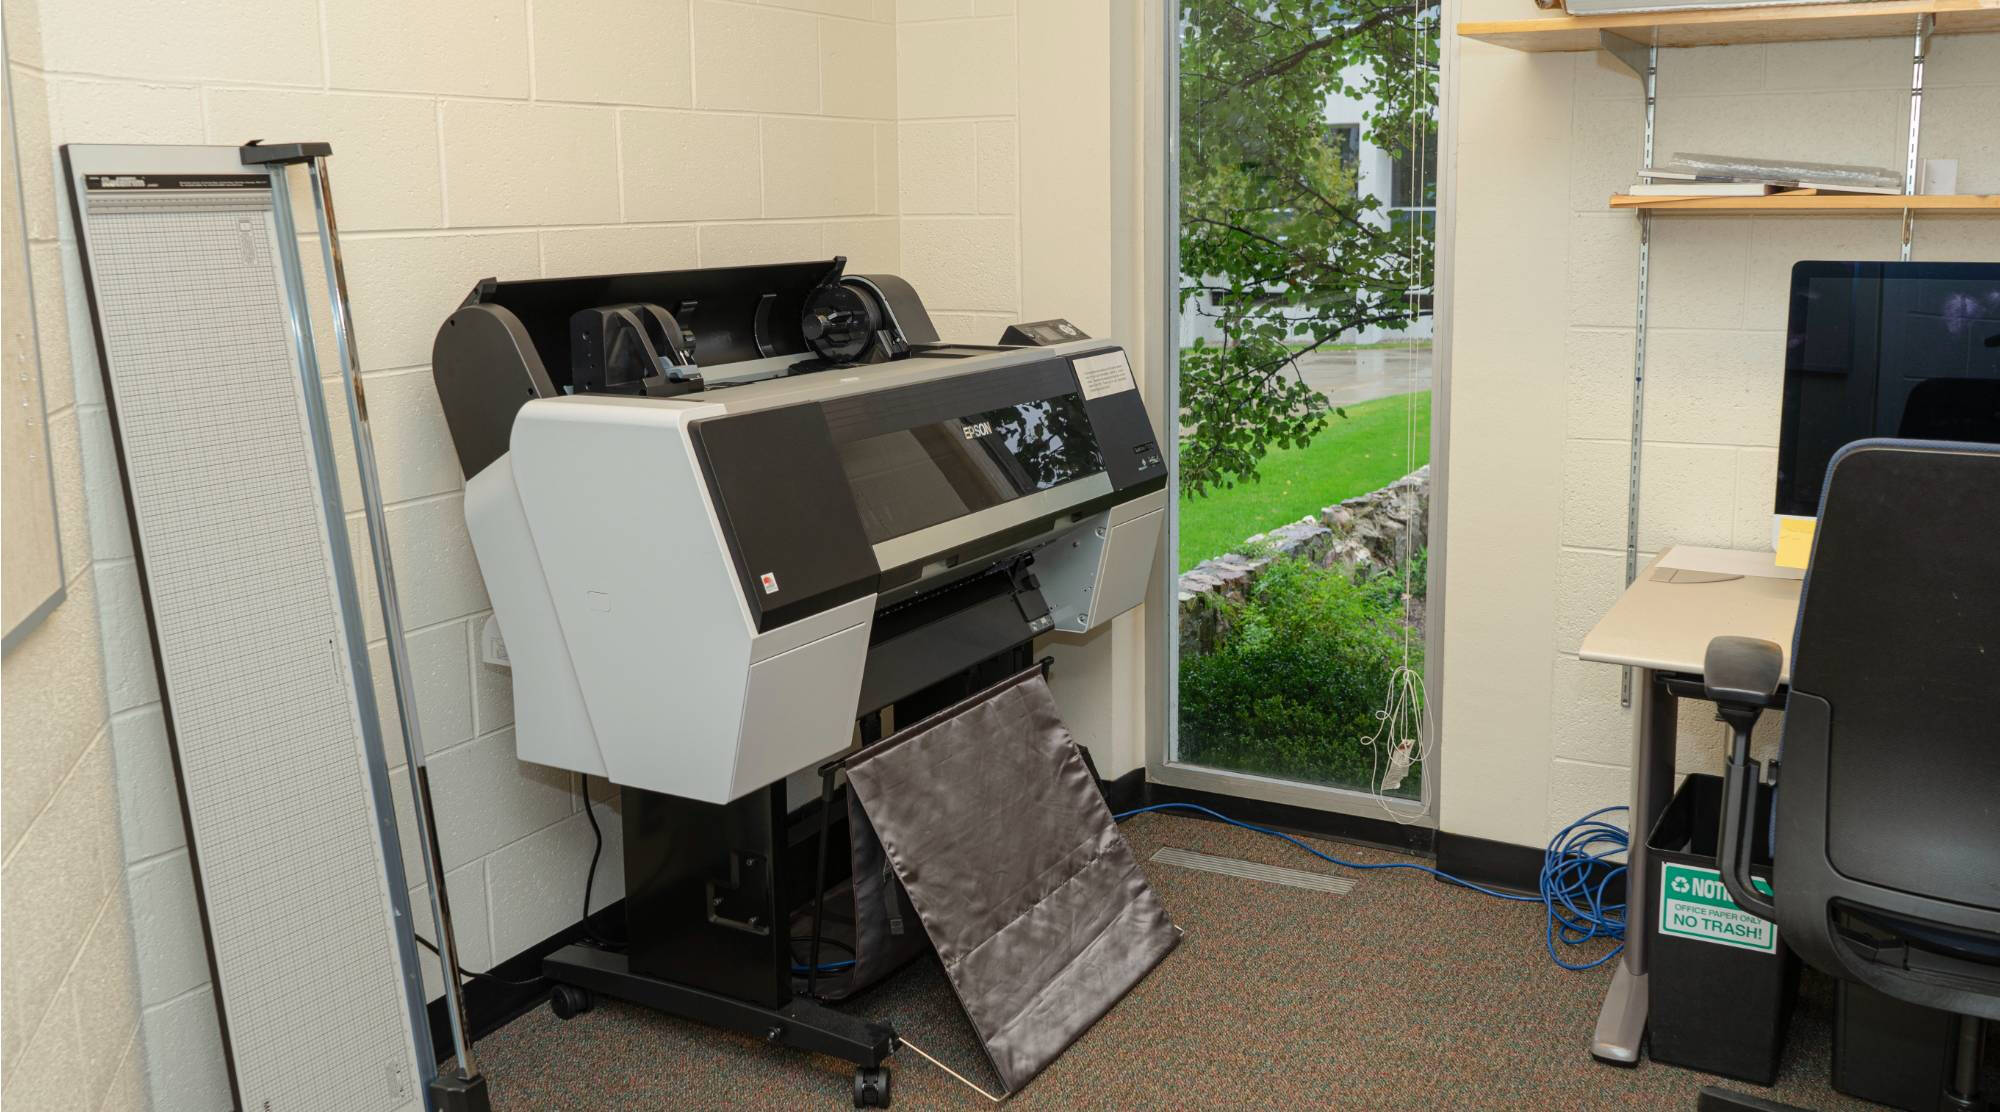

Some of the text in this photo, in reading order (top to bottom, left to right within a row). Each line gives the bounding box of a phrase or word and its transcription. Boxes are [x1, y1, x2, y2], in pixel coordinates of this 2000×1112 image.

[963, 421, 992, 439] EPSON
[1675, 903, 1762, 925] OFFICE PAPER ONLY
[1673, 913, 1762, 940] NO TRASH!
